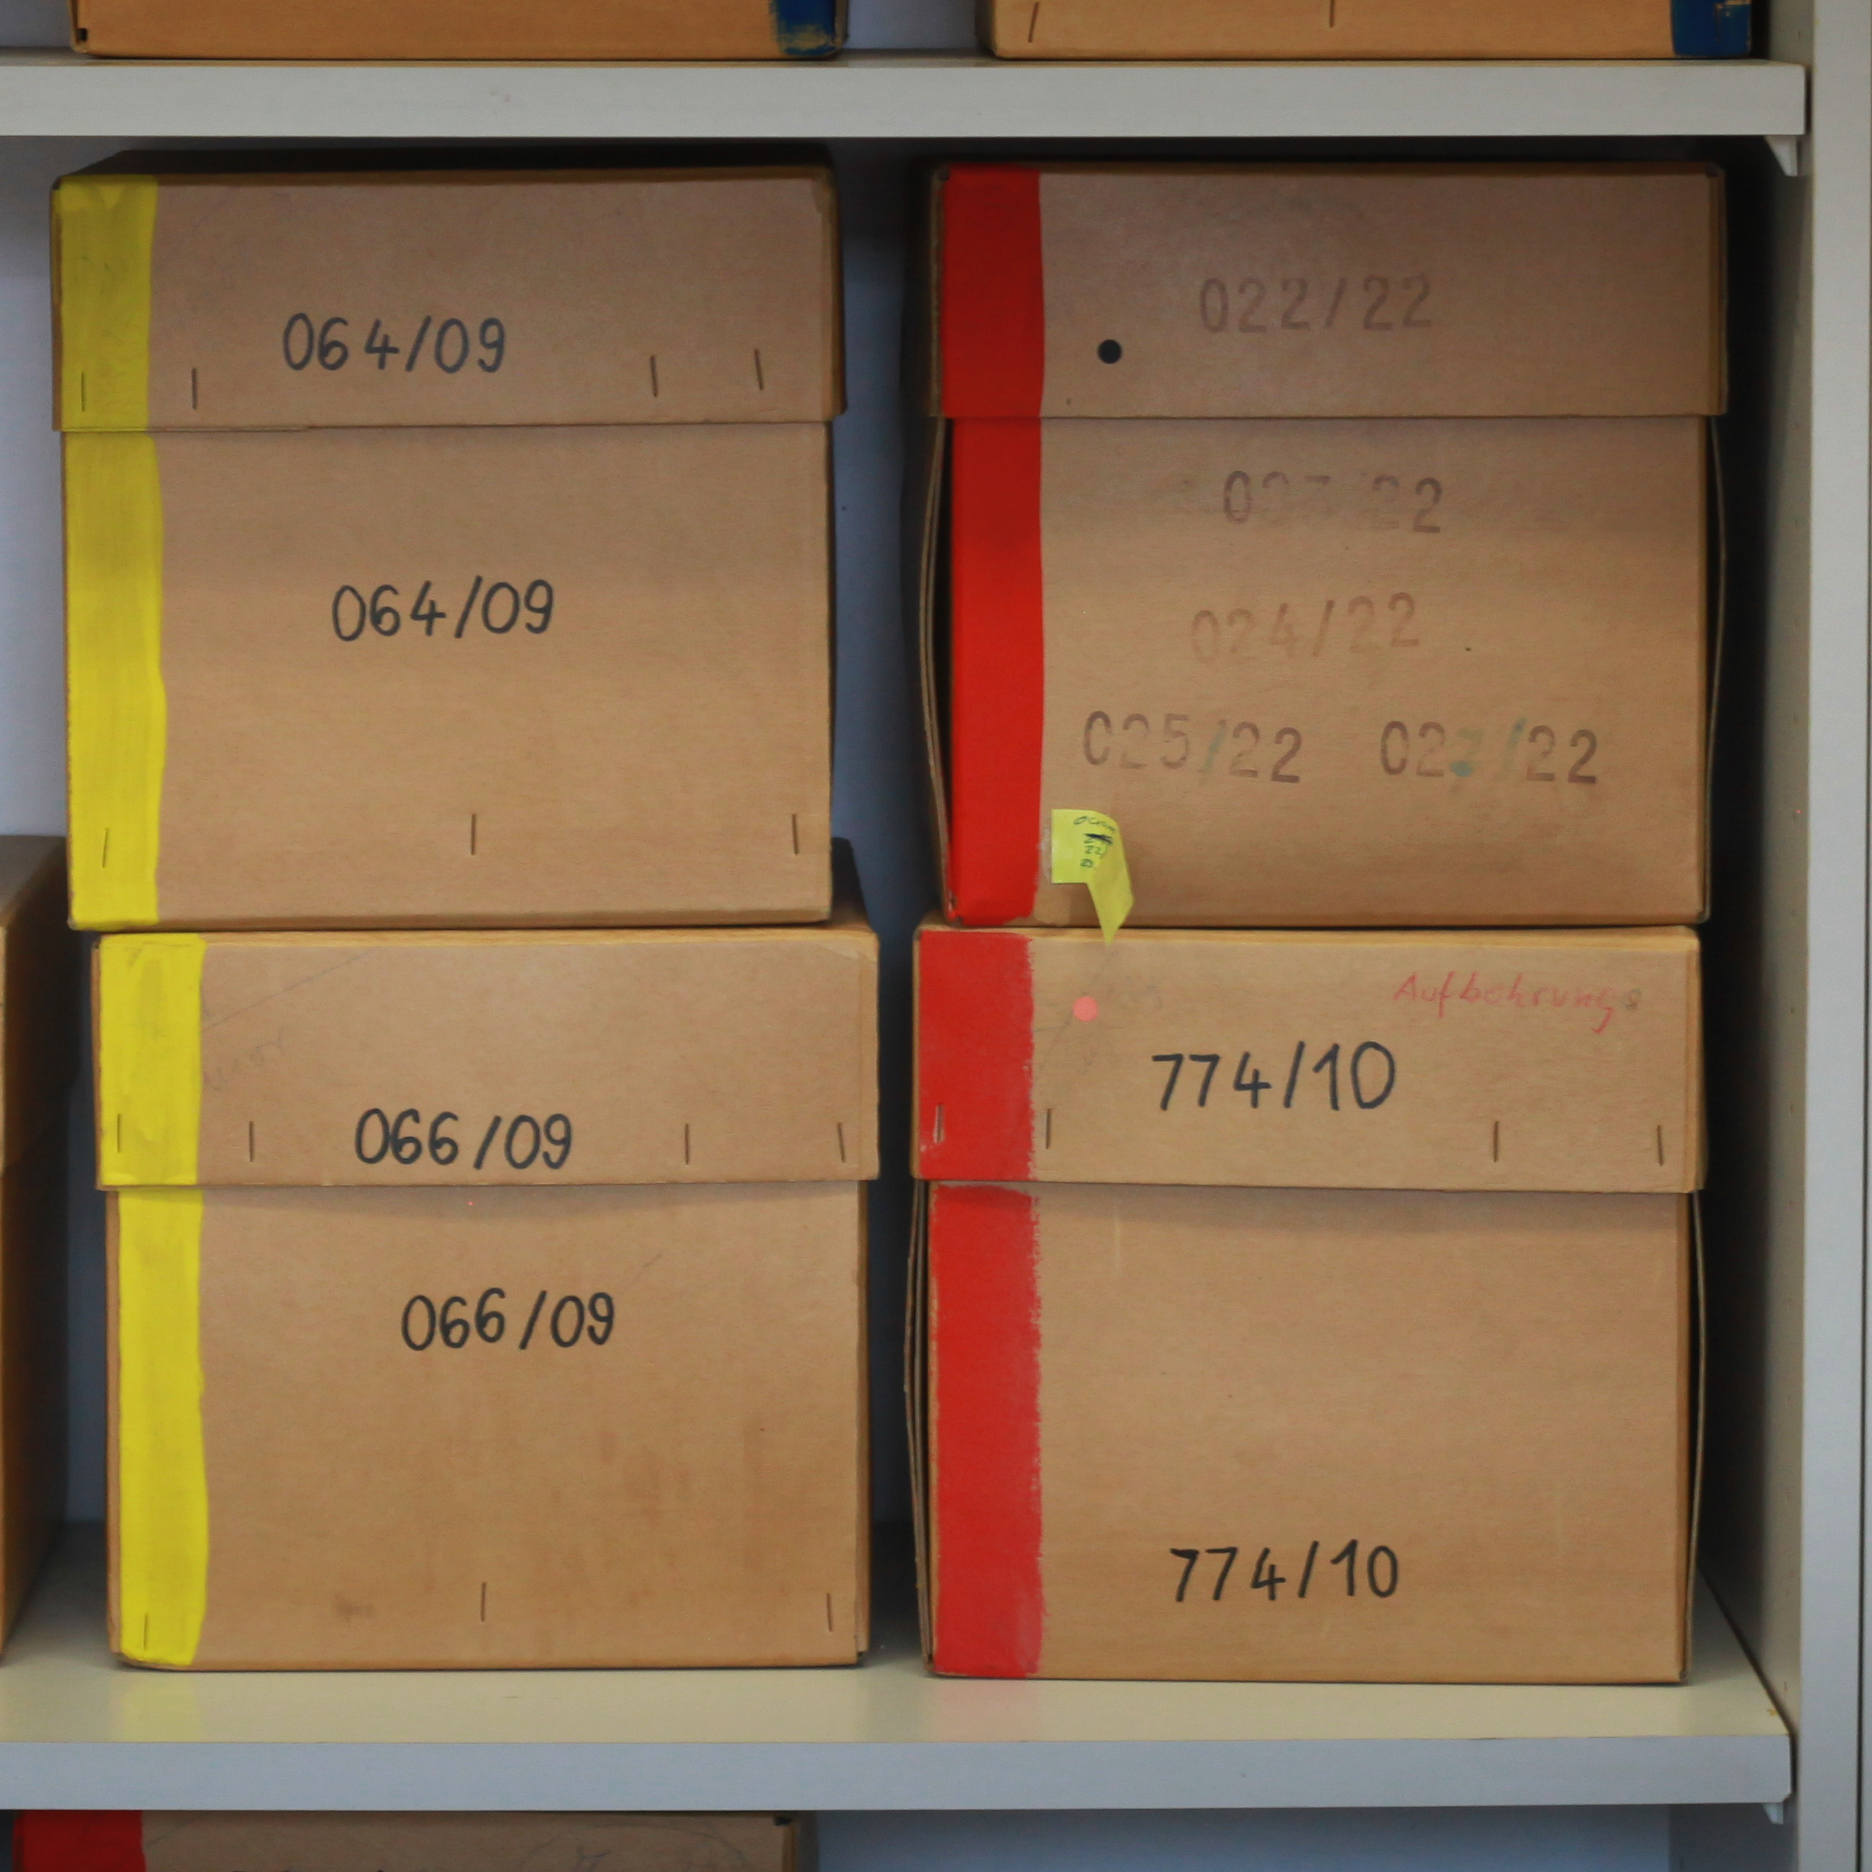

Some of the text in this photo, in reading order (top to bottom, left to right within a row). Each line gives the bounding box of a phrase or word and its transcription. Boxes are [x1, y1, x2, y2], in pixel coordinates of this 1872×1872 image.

[1200, 273, 1433, 334] 022/22
[282, 312, 507, 374] 064/09
[331, 575, 555, 642] 064/09
[1190, 592, 1420, 664] 024/22
[1083, 709, 1303, 784] 025/22
[1152, 1040, 1396, 1111] 774/10
[354, 1107, 573, 1170] 066/09
[400, 1287, 616, 1352] 066/09
[1170, 1539, 1400, 1603] 774/10
